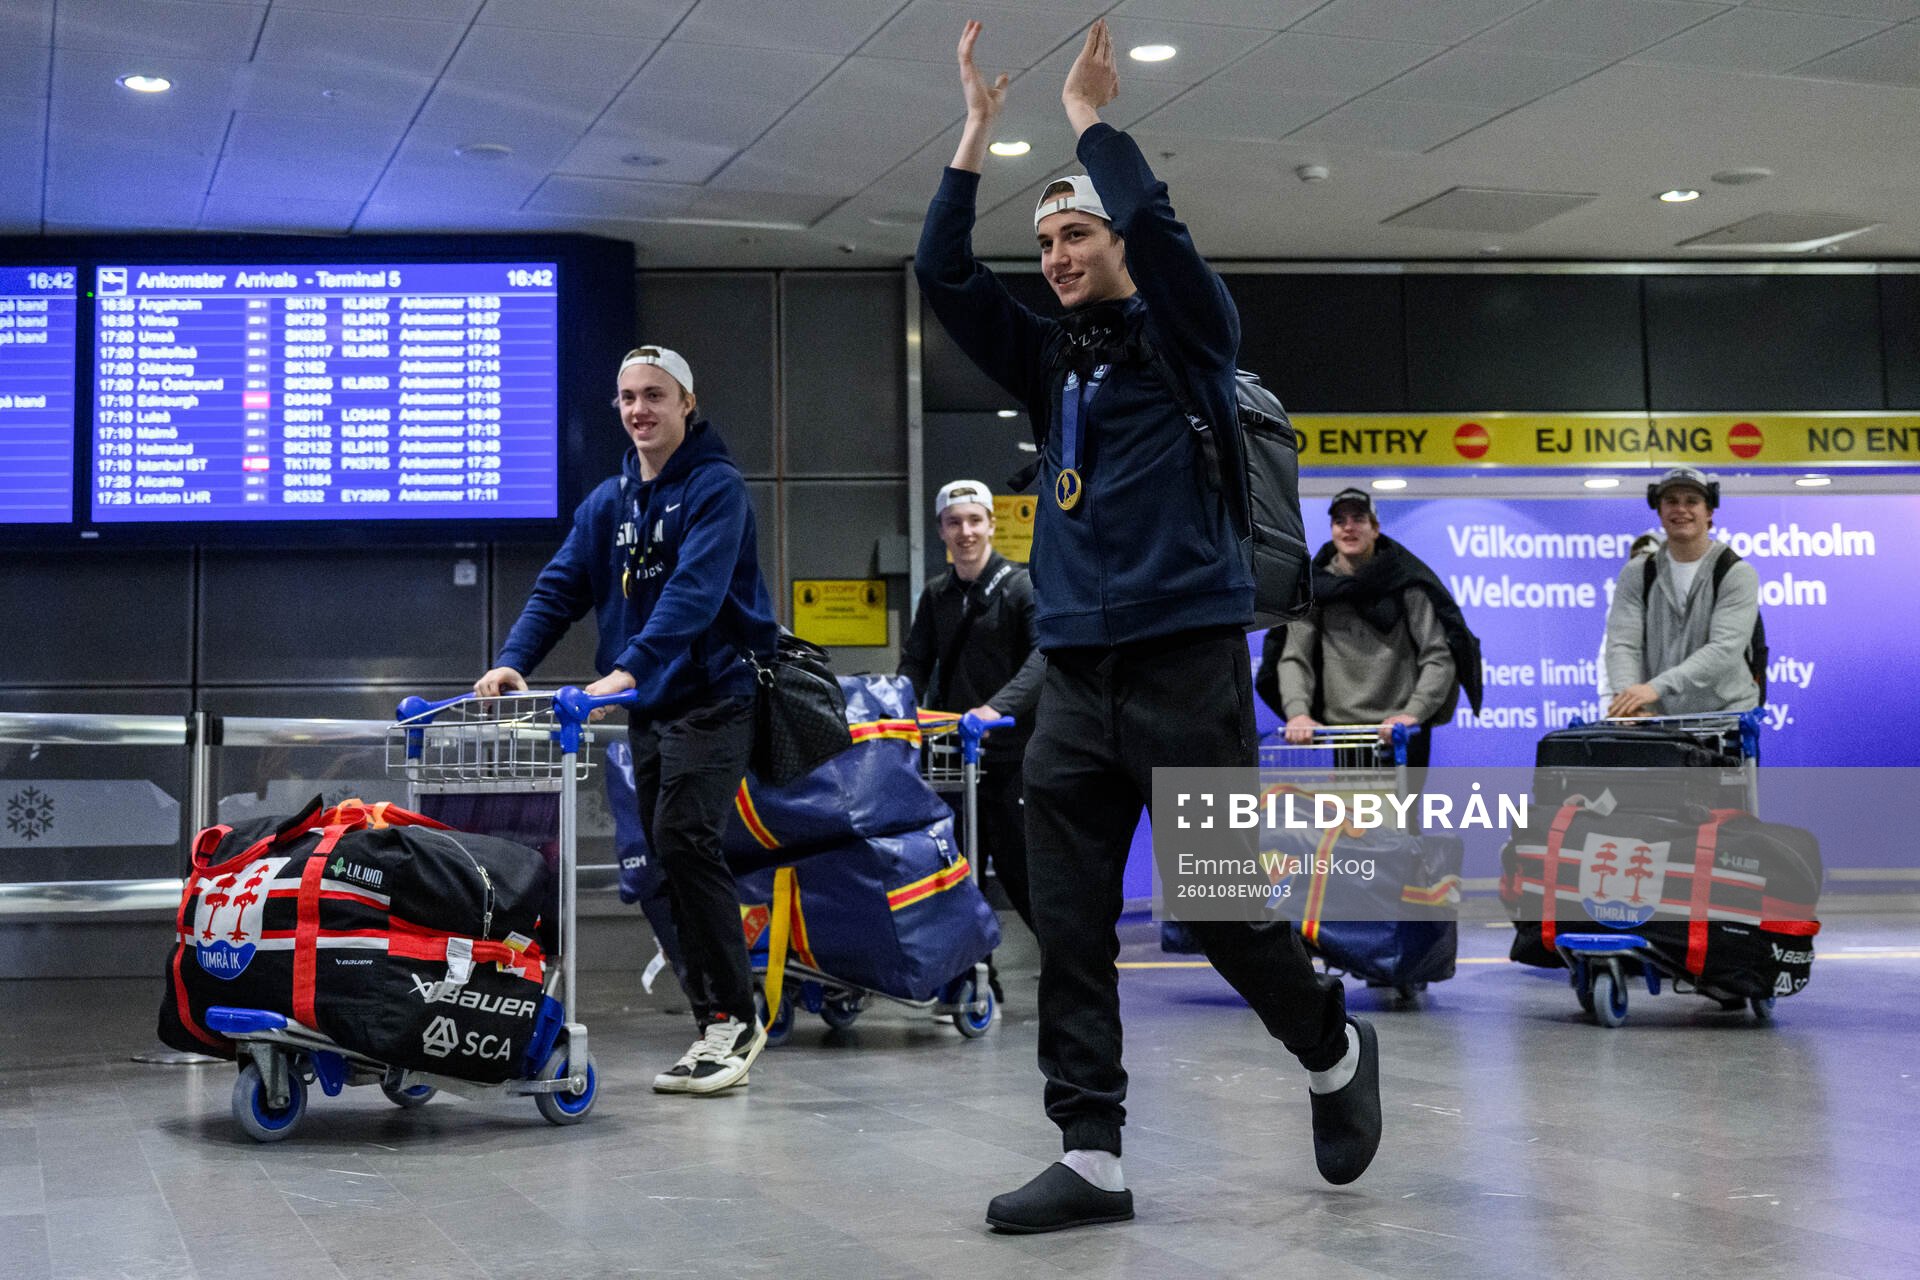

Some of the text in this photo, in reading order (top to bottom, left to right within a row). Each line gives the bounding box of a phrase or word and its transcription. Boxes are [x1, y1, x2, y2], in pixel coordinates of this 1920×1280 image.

[28, 272, 74, 289] 16:42
[136, 272, 226, 288] Ankomster
[235, 272, 298, 288] Arrivals
[315, 271, 386, 287] Terminal
[388, 271, 402, 287] 5
[507, 270, 553, 287] 16:42
[1319, 429, 1429, 454] ENTRY
[1536, 420, 1713, 454] EJ INGÅNG
[1807, 427, 1855, 453] NO
[136, 459, 184, 472] Istanbul
[186, 459, 209, 472] IST
[135, 475, 185, 488] Alicante
[98, 491, 131, 504] 17:25
[135, 491, 182, 504] London
[183, 491, 211, 504] LHR
[467, 488, 498, 501] 17:11
[1708, 523, 1876, 557] tockholm
[1449, 575, 1596, 608] Welcome
[1481, 658, 1535, 686] here
[1456, 706, 1538, 729] means
[346, 861, 384, 886] LILIUM
[201, 946, 242, 970] TIMRÅ IK
[461, 1031, 512, 1061] SCA
